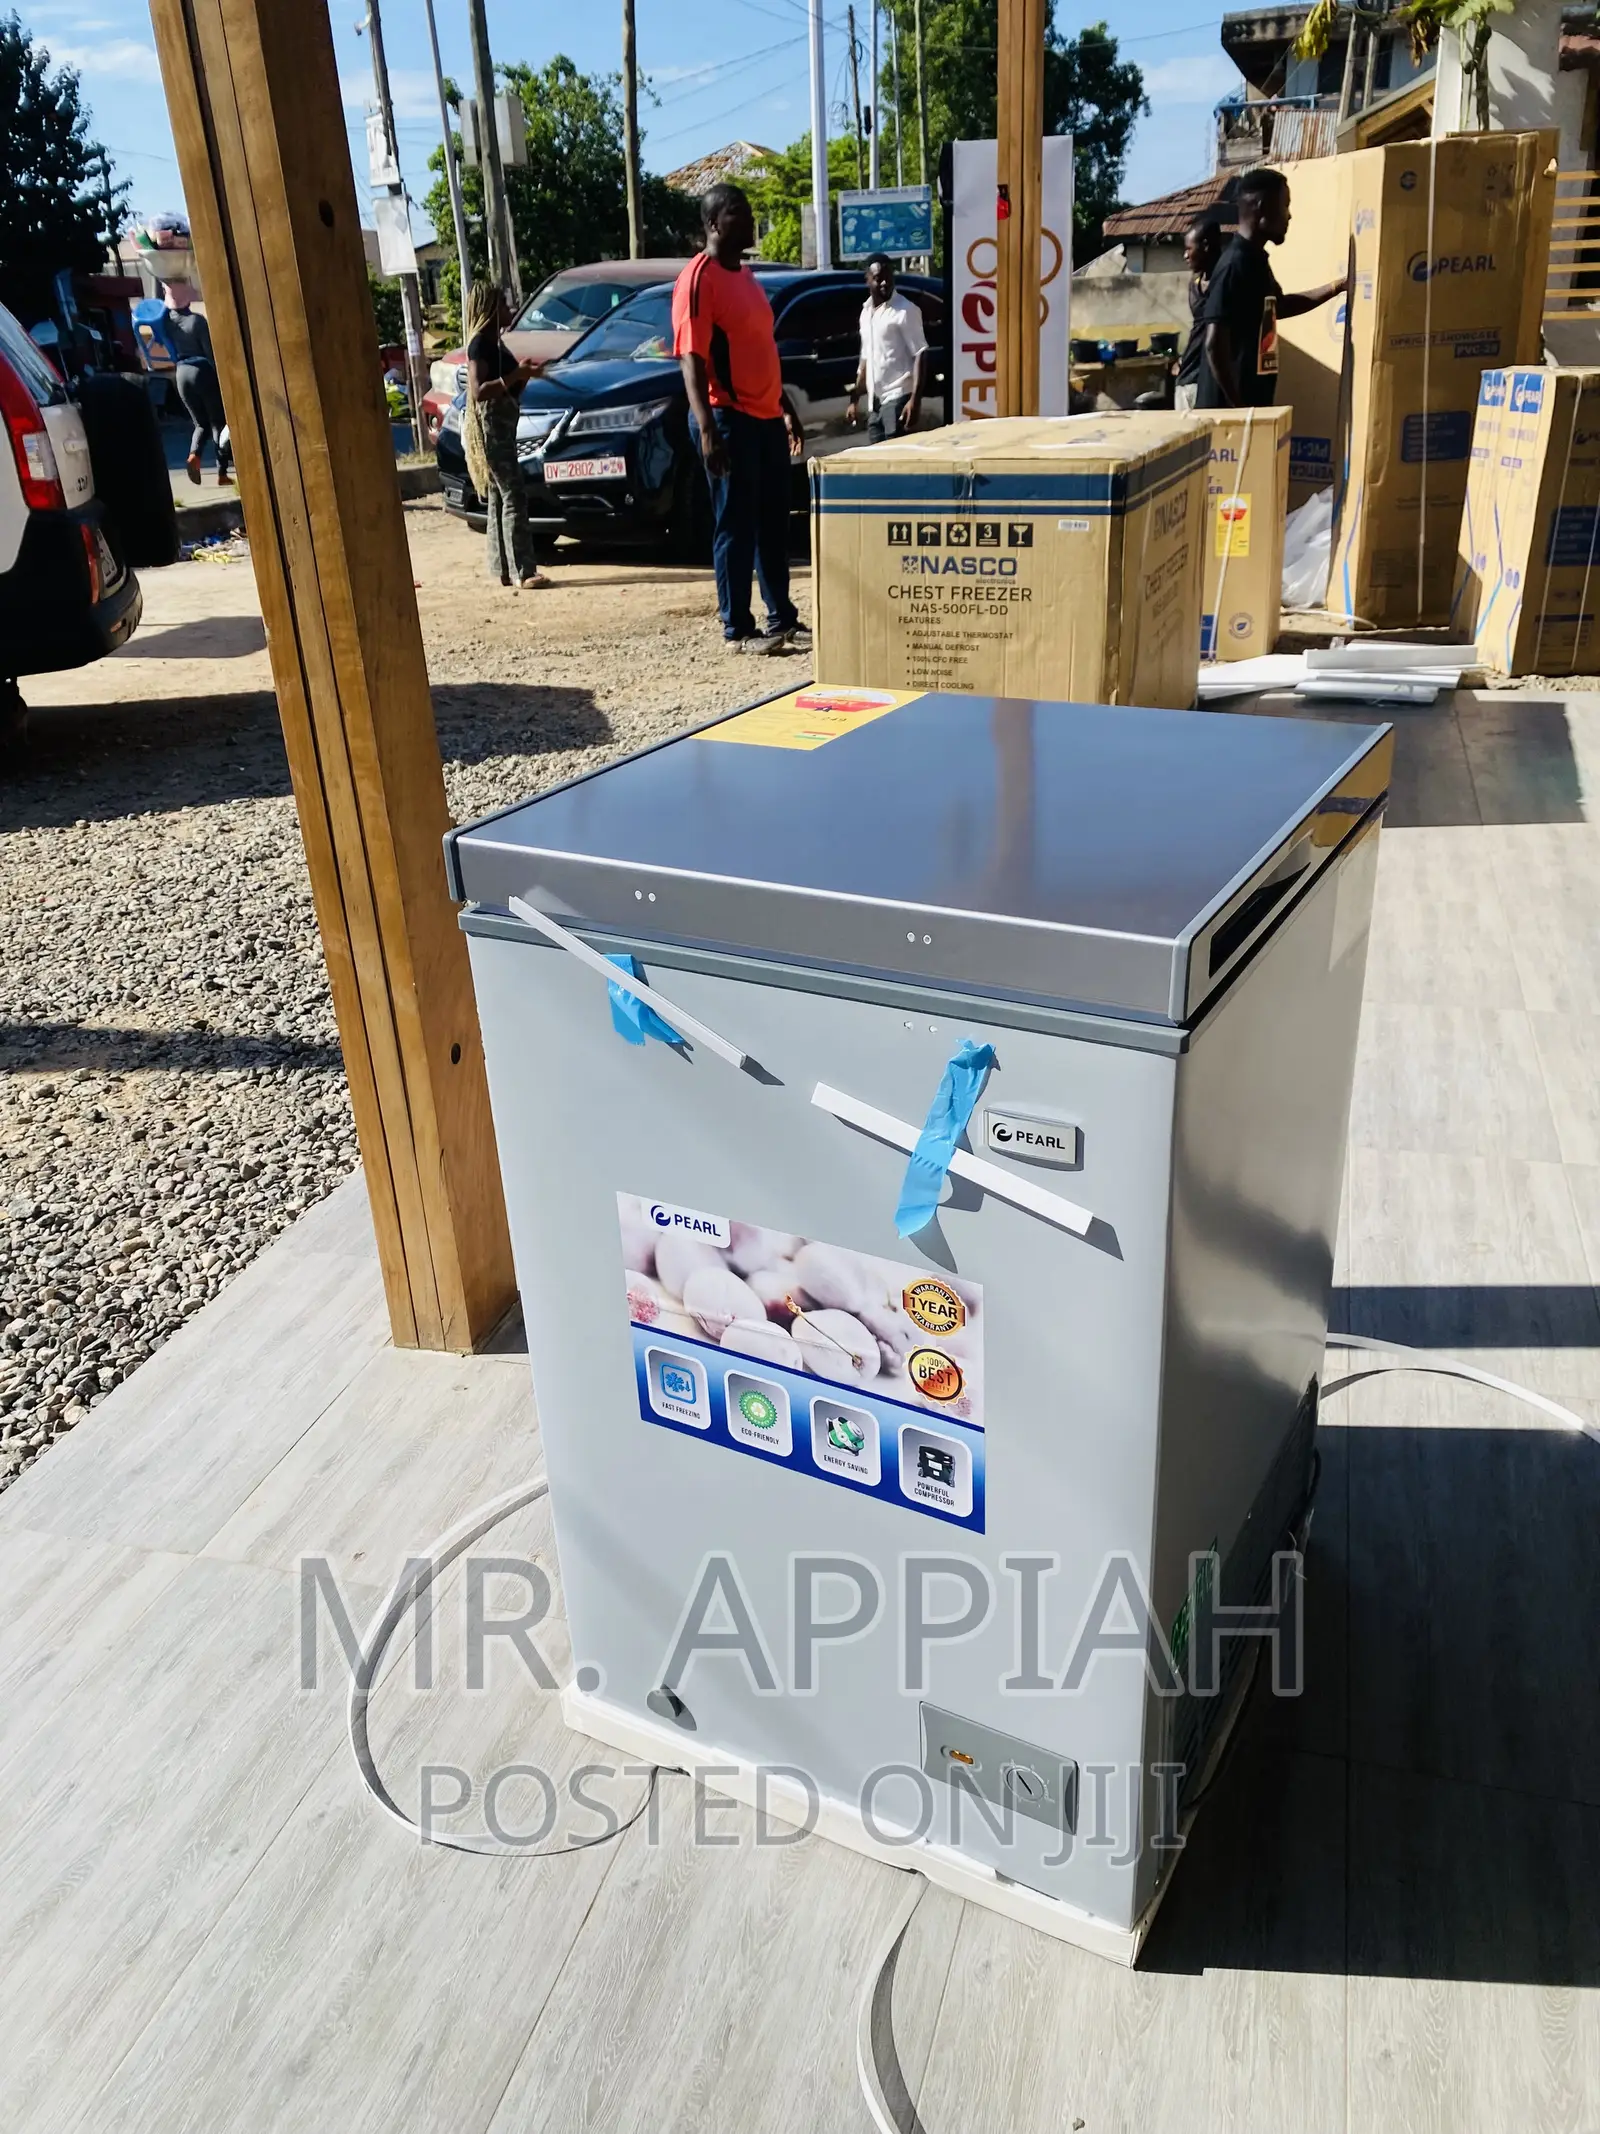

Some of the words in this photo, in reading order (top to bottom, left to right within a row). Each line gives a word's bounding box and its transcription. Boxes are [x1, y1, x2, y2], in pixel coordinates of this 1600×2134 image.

[1438, 254, 1497, 275] PEARL
[1208, 449, 1239, 462] ARL
[921, 555, 1018, 576] NASCO
[888, 585, 944, 600] CHEST
[951, 587, 1032, 602] FREEZER
[910, 603, 1008, 616] NAS-500FL-DD
[912, 630, 960, 638] ADJUSTABLE
[963, 631, 1013, 639] THERMOSTAT
[912, 643, 942, 651] MANUAL
[945, 644, 980, 652] DEFROST
[949, 656, 968, 664] FREE
[912, 668, 929, 676] LOW
[912, 681, 939, 689] DIRECT
[941, 682, 974, 690] COOLING
[1016, 1130, 1066, 1150] PEARL
[674, 1213, 722, 1237] PEARL
[913, 1284, 954, 1303] WARRANTY
[910, 1296, 916, 1309] 1
[918, 1298, 958, 1320] YEAR
[914, 1312, 954, 1332] WARRANTY
[926, 1356, 946, 1368] 100%
[919, 1364, 953, 1387] BEST
[662, 1402, 675, 1411] FAST
[675, 1406, 701, 1420] FREEZING
[741, 1427, 780, 1445] ECO-FRIENDLY
[823, 1454, 846, 1468] ENERGY
[847, 1461, 869, 1475] SAVING
[914, 1487, 955, 1507] COMPRESSOR
[917, 1481, 950, 1498] POWERFUL
